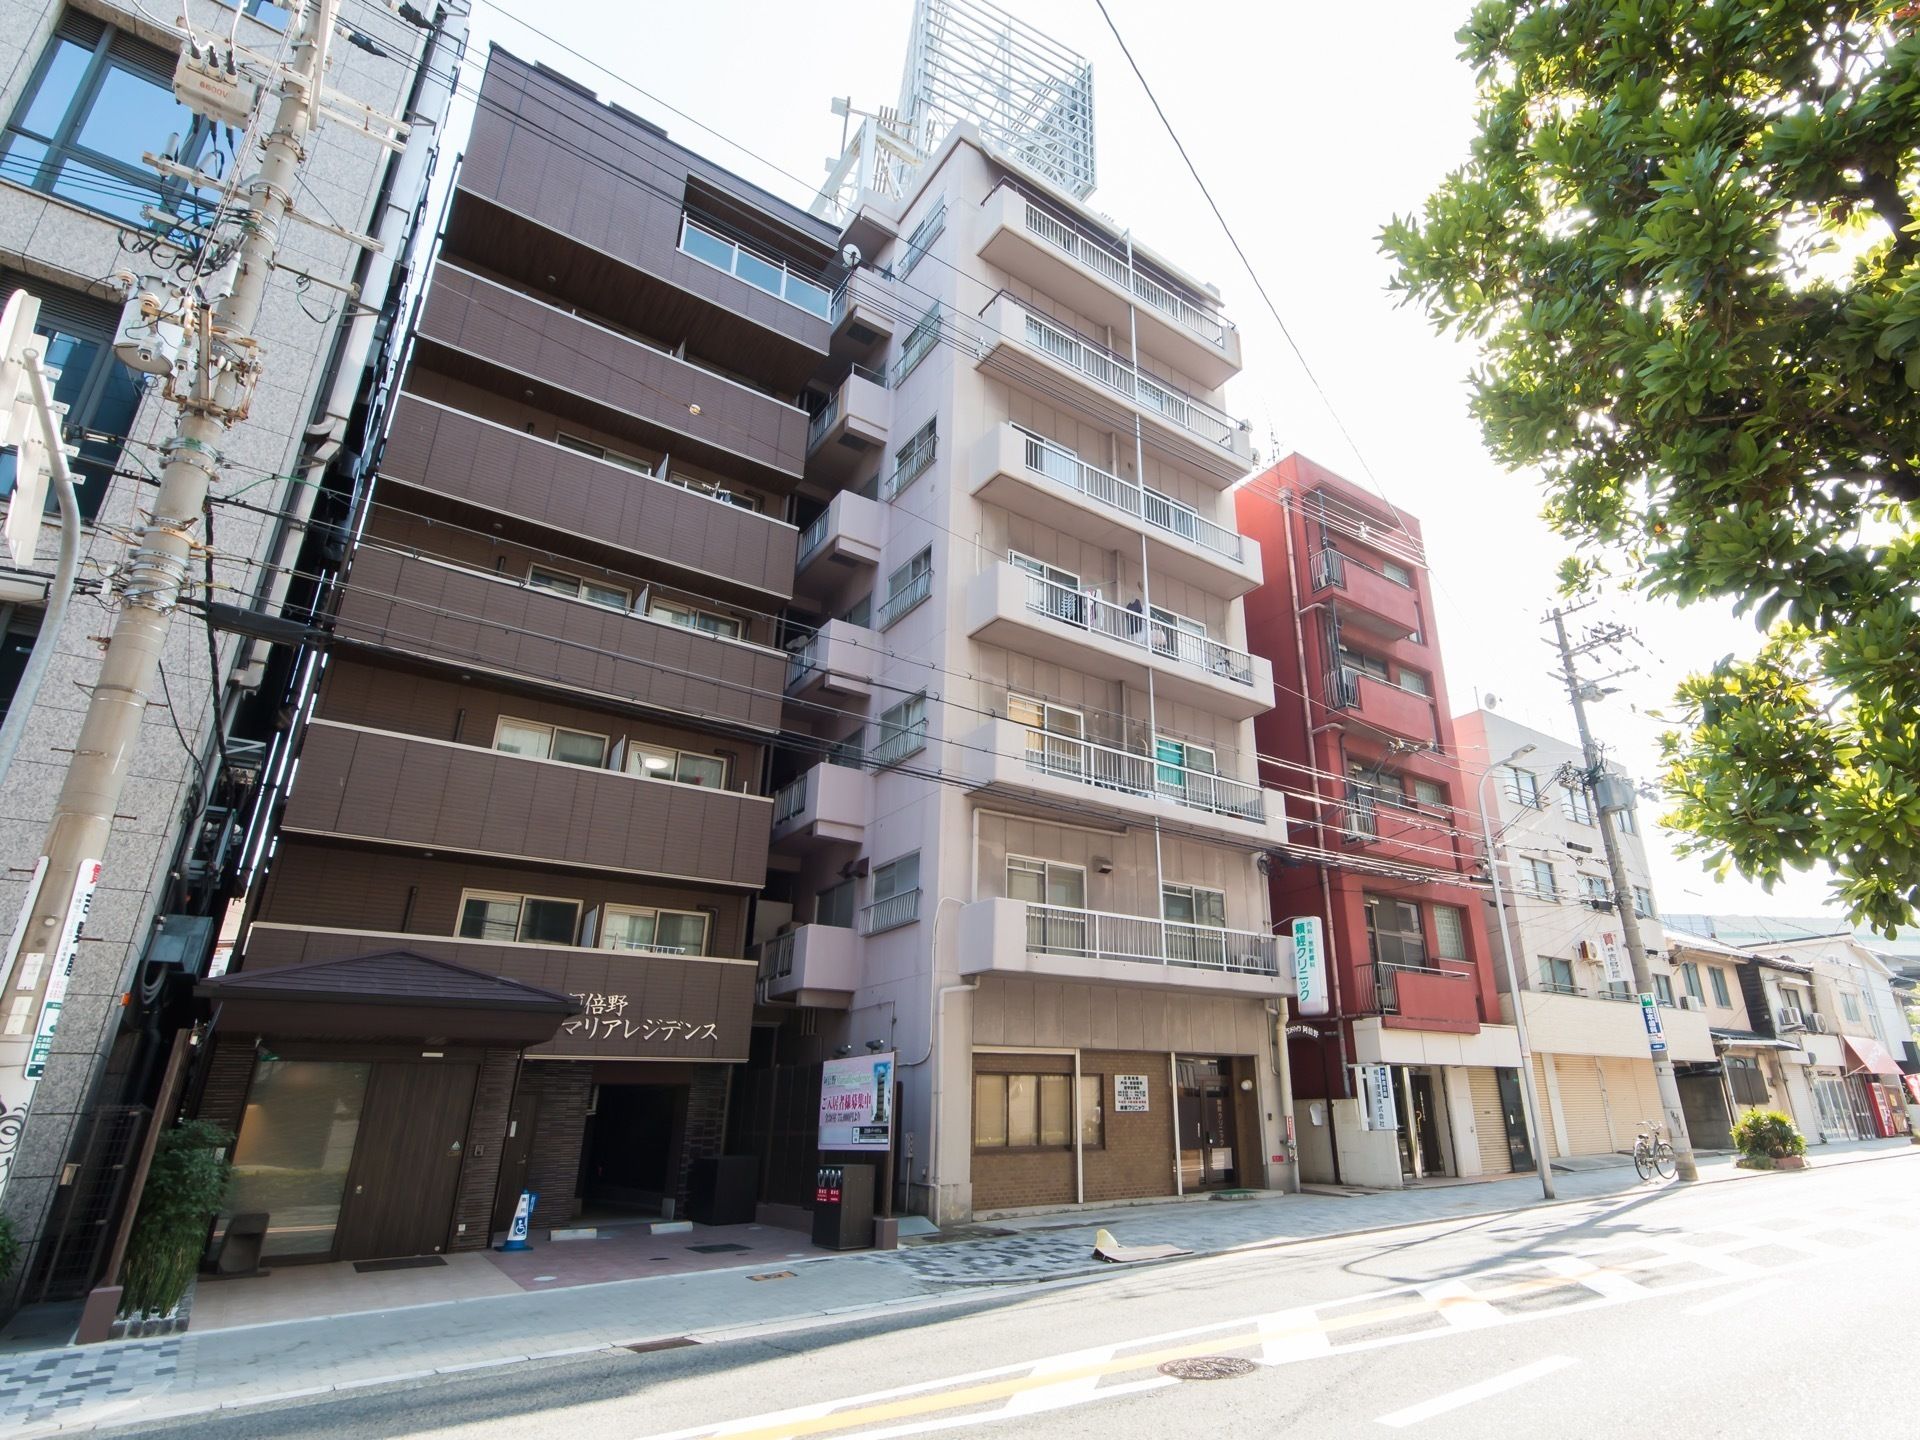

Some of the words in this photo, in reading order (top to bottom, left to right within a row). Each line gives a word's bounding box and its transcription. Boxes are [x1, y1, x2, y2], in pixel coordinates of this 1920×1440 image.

[561, 1017, 718, 1041] マリアレジデンス
[821, 1093, 872, 1111] ご入居者様募集中
